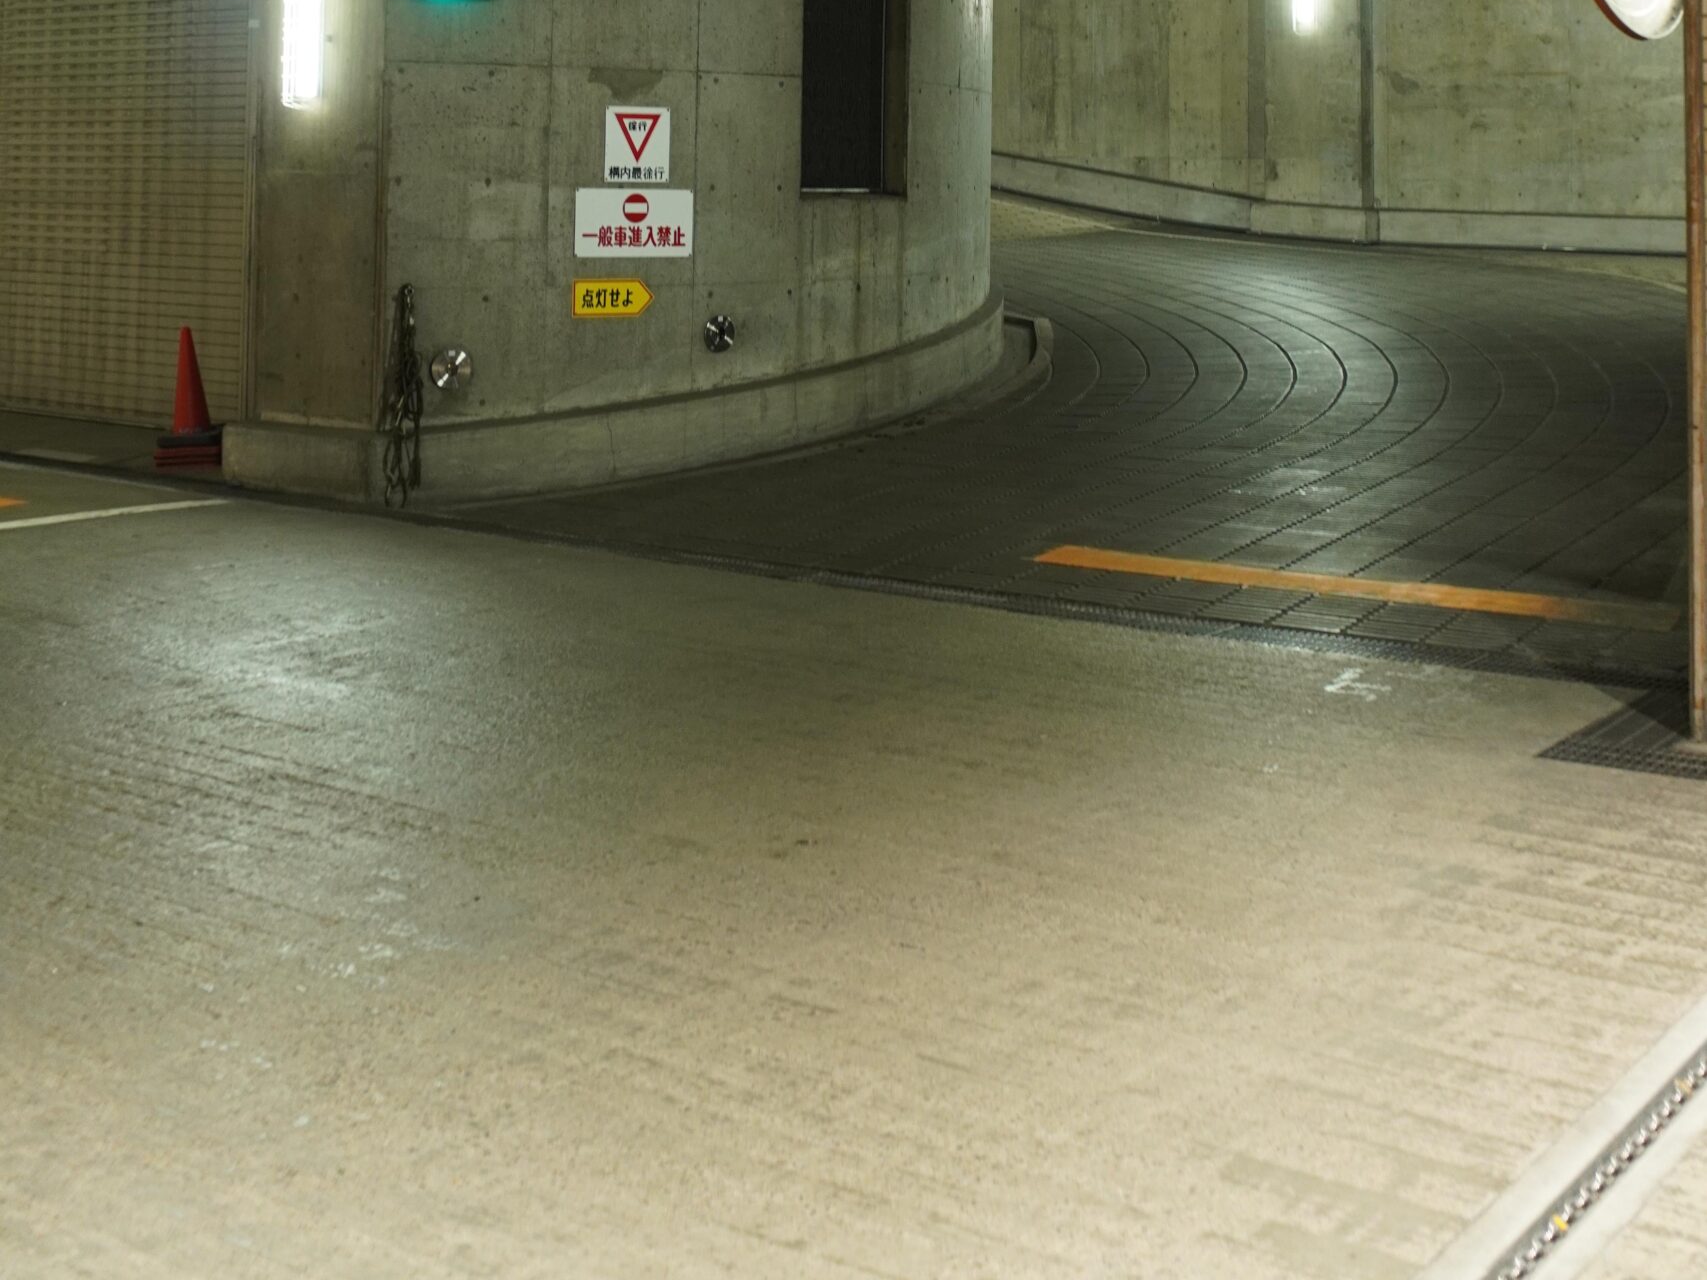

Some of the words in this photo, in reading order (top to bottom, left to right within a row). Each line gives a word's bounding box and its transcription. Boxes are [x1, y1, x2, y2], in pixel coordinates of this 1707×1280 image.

[609, 166, 665, 180] 構内最徐行
[582, 225, 686, 248] 一般車進入禁止
[581, 288, 634, 309] 点灯せよ
